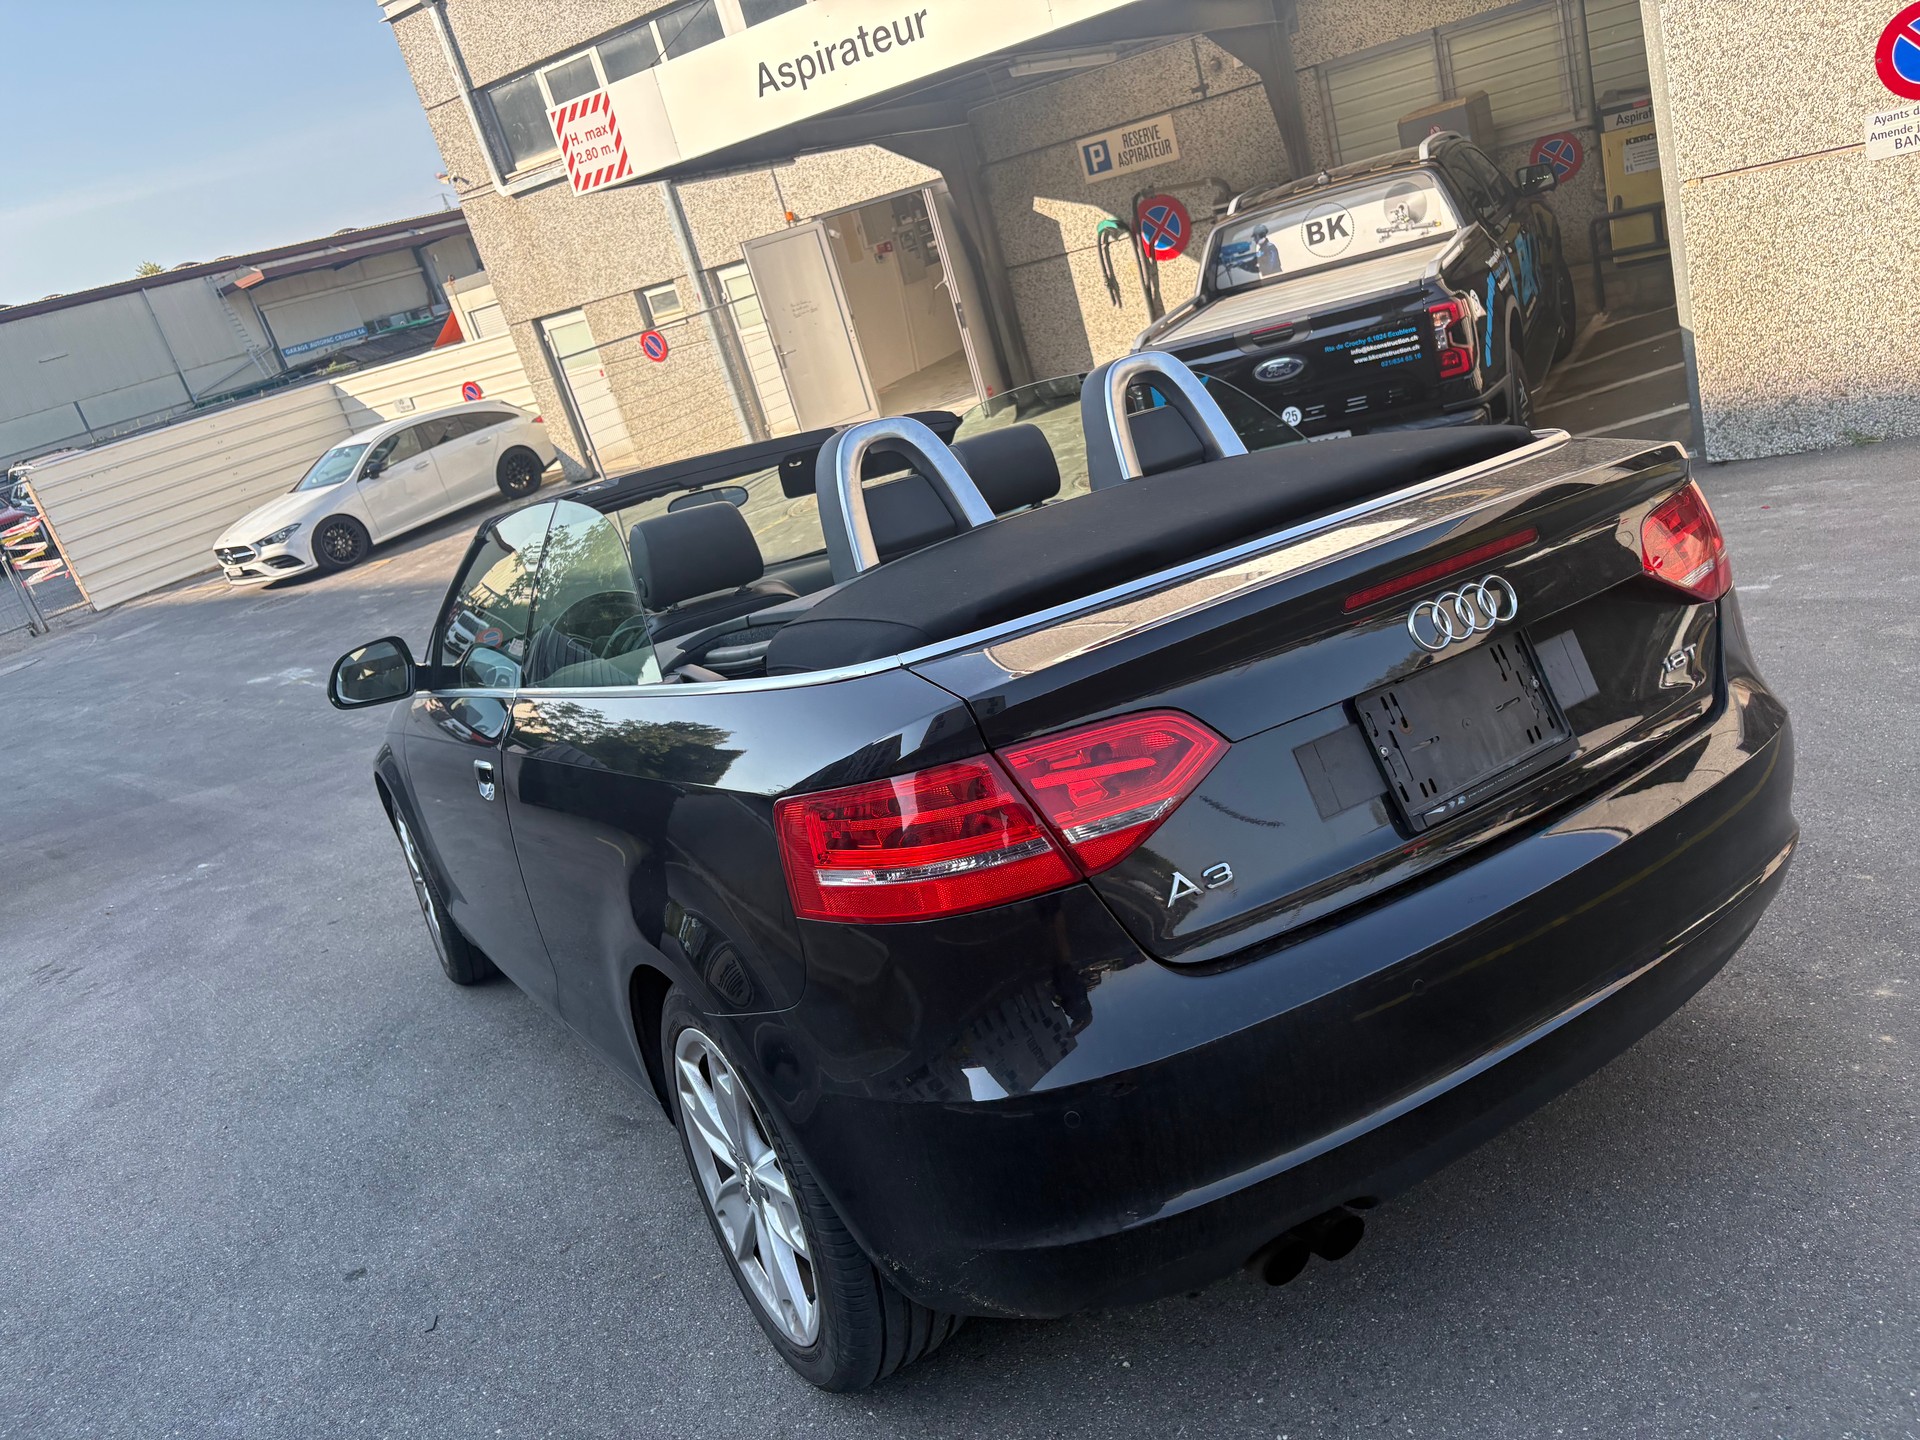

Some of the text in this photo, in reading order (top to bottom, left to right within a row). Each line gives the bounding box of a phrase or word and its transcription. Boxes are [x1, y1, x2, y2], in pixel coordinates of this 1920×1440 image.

[758, 8, 927, 98] Aspirateur
[1873, 110, 1910, 126] Ayants
[569, 124, 608, 147] H. max
[1121, 124, 1161, 149] RESERVE
[1870, 124, 1913, 142] Amende
[576, 145, 614, 164] 2.80 m.
[1088, 143, 1105, 172] P
[1117, 138, 1173, 168] ASPIRATEUR
[1305, 213, 1350, 246] BK
[285, 343, 309, 355] GARAGE
[1350, 334, 1419, 356] info@bkconstruction.ch
[1353, 344, 1420, 364] www.bkconstruction.ch
[1266, 363, 1292, 378] Ford
[1285, 409, 1299, 423] 25
[1166, 862, 1234, 908] A3
